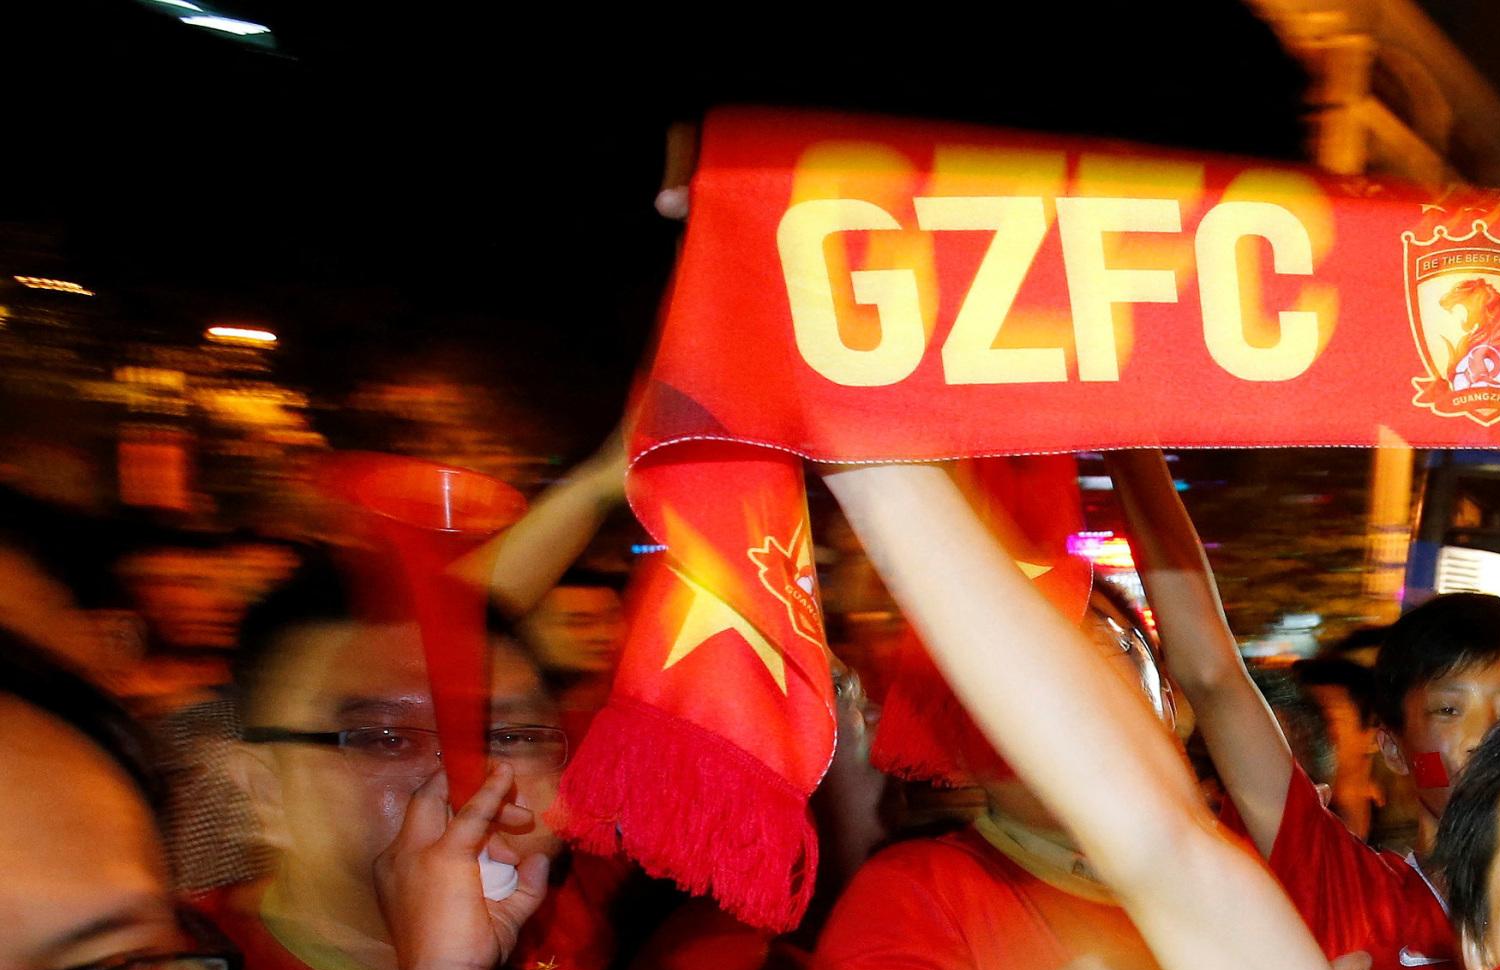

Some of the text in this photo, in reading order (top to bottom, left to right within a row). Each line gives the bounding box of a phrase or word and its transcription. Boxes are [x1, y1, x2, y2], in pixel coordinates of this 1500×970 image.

[776, 195, 1321, 388] GZFC
[1423, 259, 1439, 271] BE
[1442, 254, 1464, 267] THE
[1465, 253, 1491, 264] BEST
